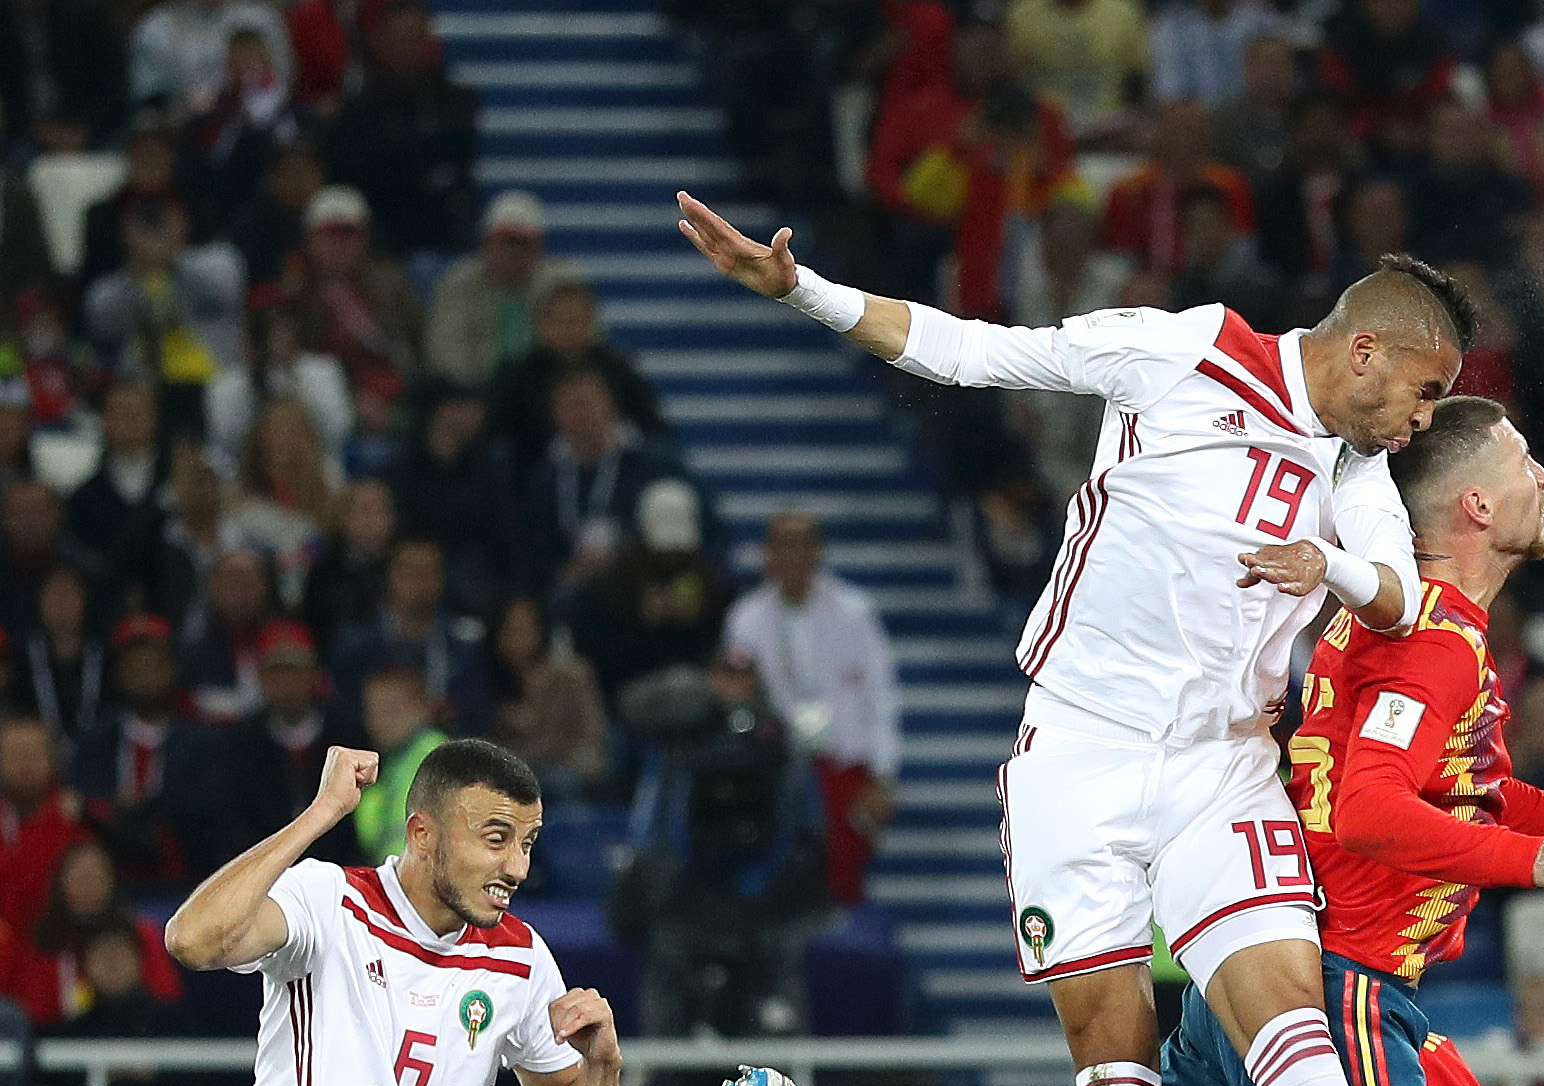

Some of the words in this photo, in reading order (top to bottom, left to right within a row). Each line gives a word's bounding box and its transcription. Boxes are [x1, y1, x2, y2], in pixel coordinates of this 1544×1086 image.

[1212, 420, 1249, 437] adidas
[1234, 446, 1317, 540] 19
[1232, 818, 1313, 890] 19
